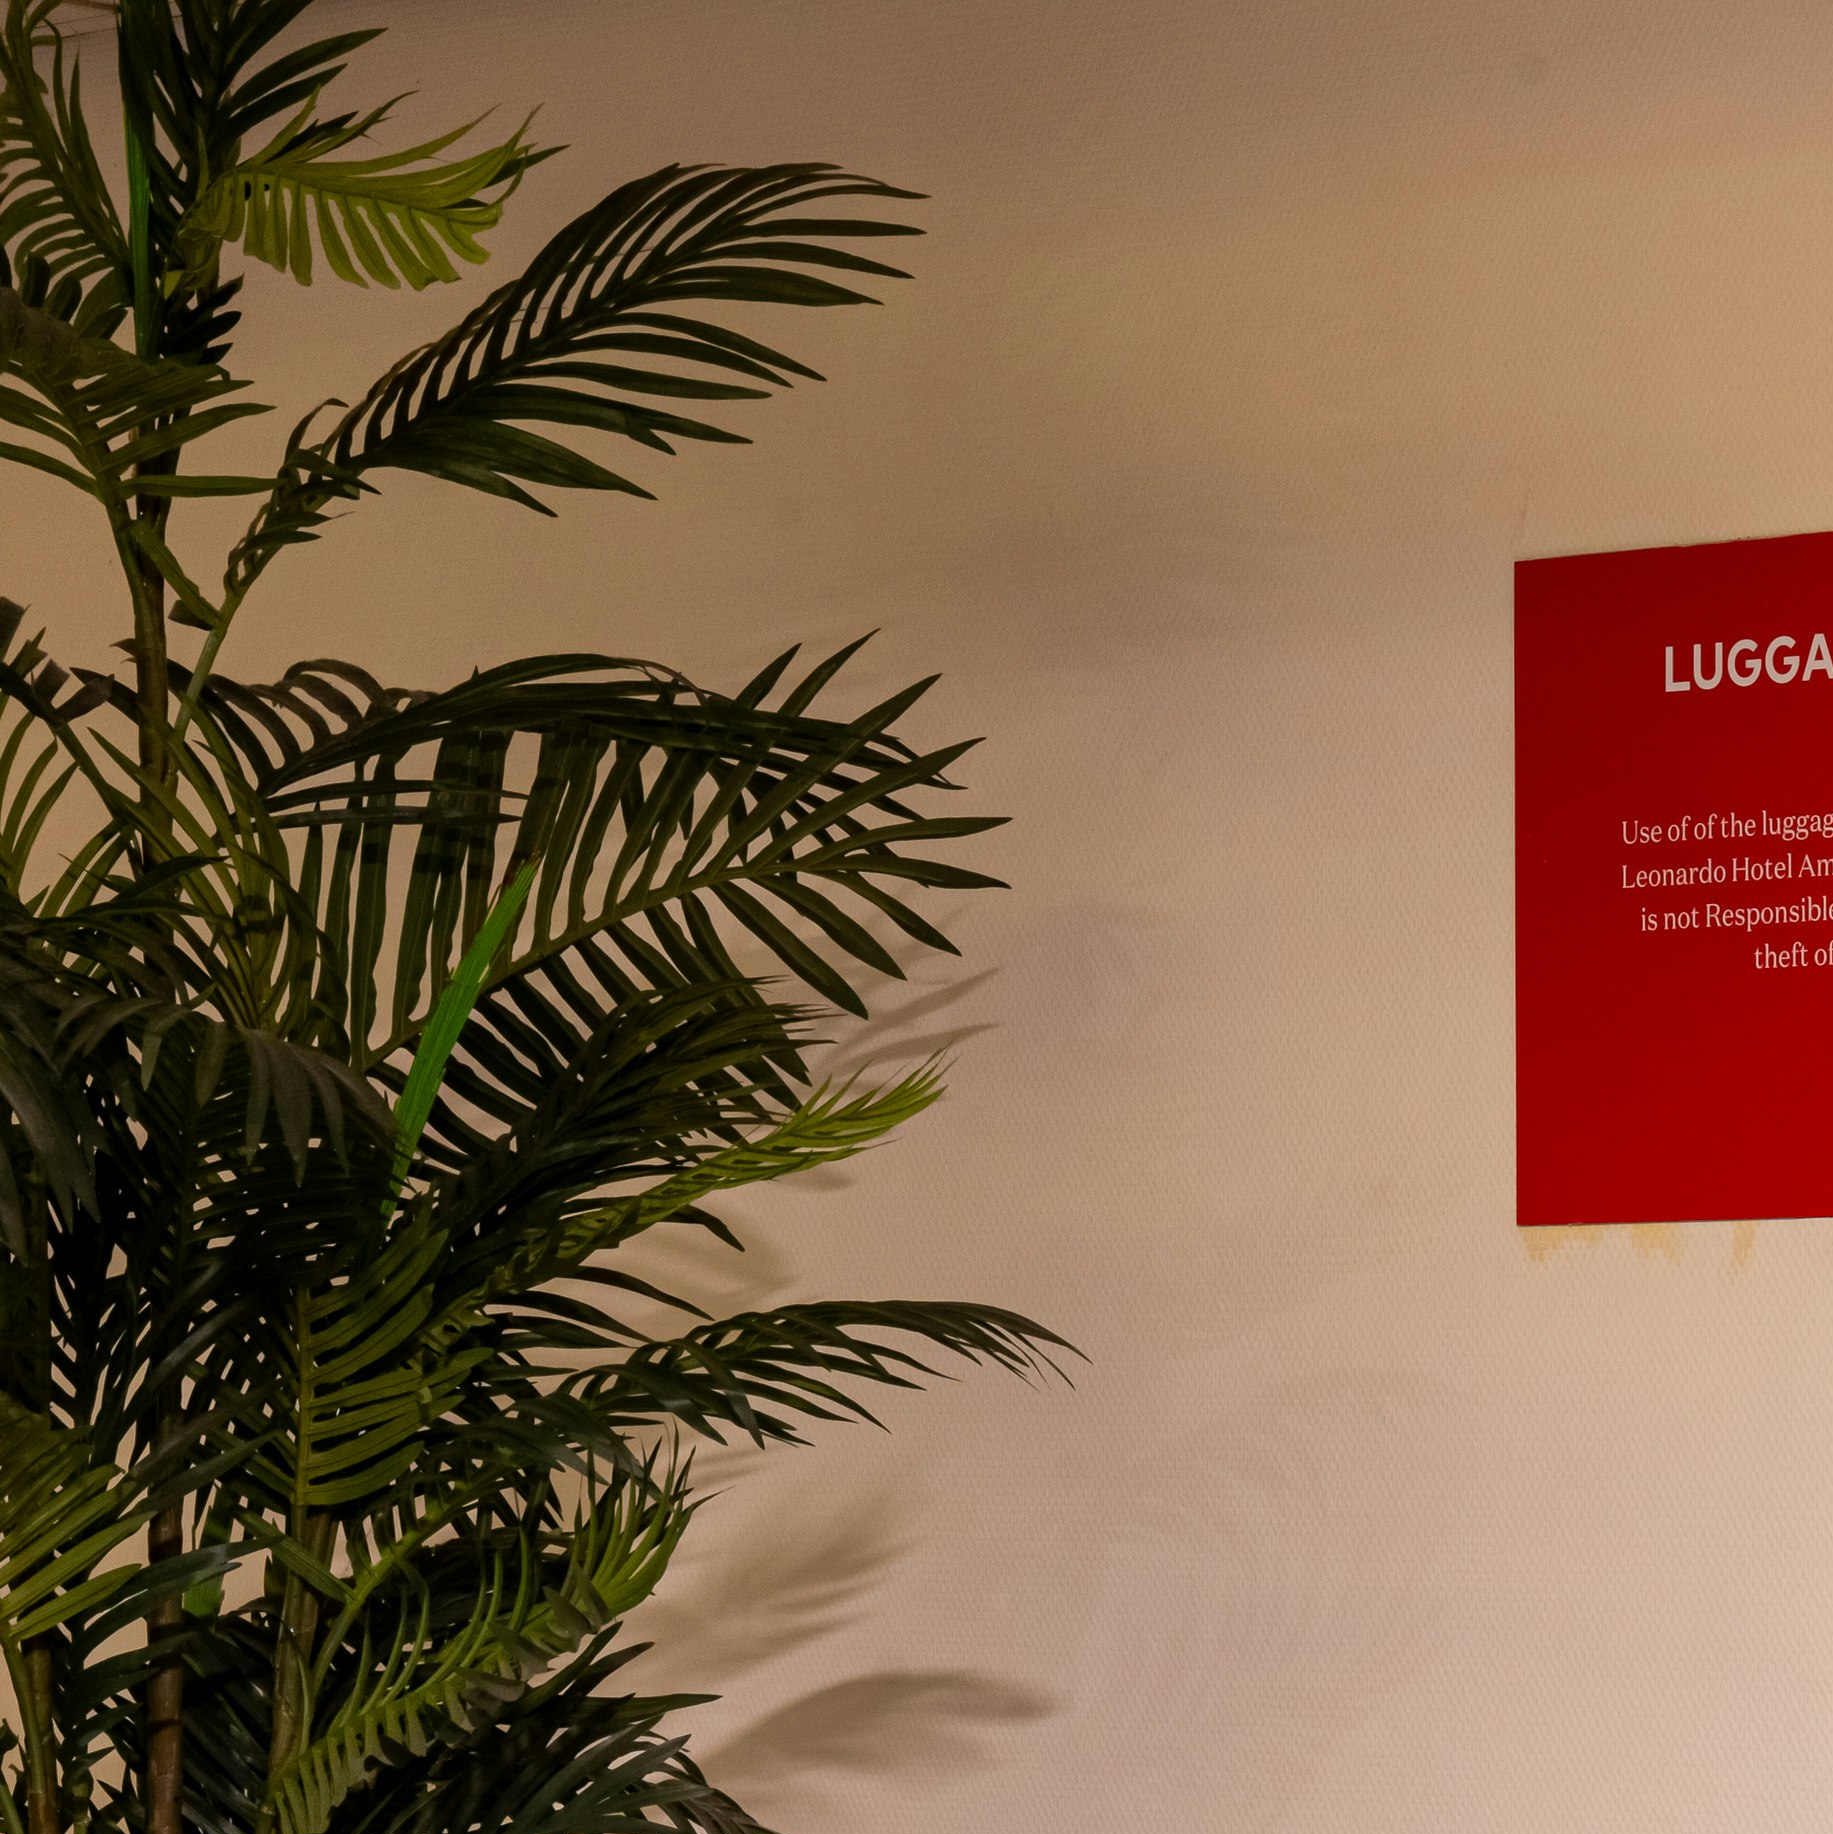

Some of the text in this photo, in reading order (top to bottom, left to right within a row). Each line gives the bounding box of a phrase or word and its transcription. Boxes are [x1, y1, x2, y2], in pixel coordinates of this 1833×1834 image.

[1623, 821, 1662, 844] Use
[1668, 816, 1691, 842] of
[1694, 814, 1717, 839] of
[1721, 812, 1756, 838] the
[1623, 858, 1726, 888] Leonardo
[1733, 853, 1792, 881] Hotel
[1642, 907, 1657, 931] is
[1664, 908, 1699, 929] not
[1755, 942, 1808, 969] theft
